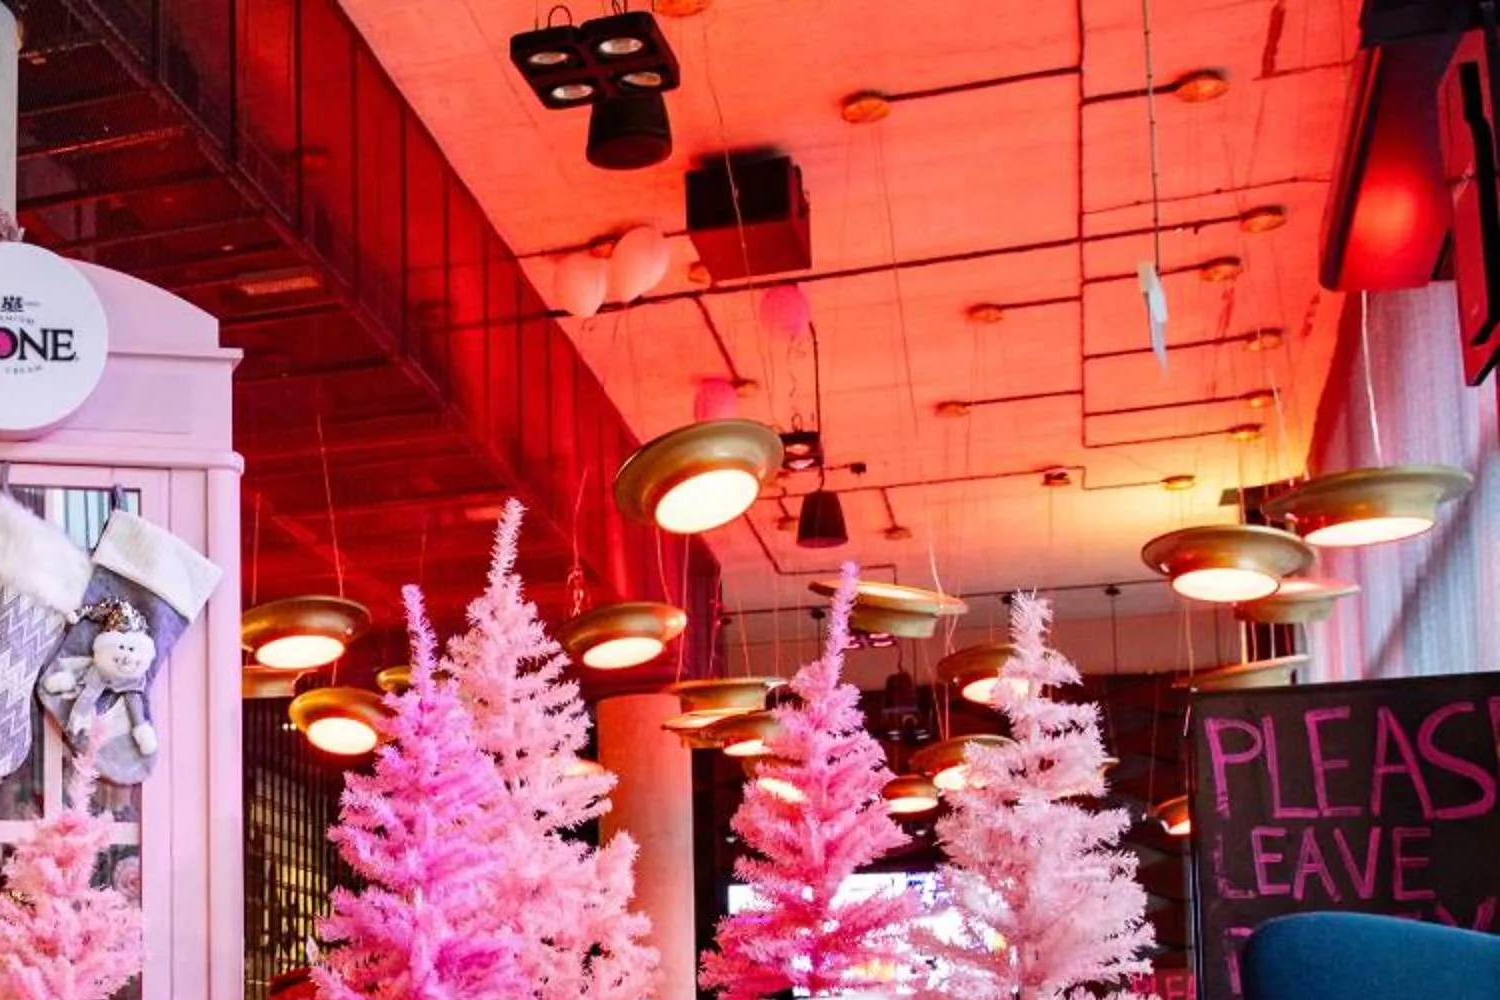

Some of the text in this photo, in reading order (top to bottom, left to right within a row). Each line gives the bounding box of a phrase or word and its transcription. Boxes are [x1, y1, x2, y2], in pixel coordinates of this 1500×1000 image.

[5, 364, 43, 376] CREAM
[1205, 696, 1500, 820] PLEAS
[1213, 827, 1437, 902] LEAVE
